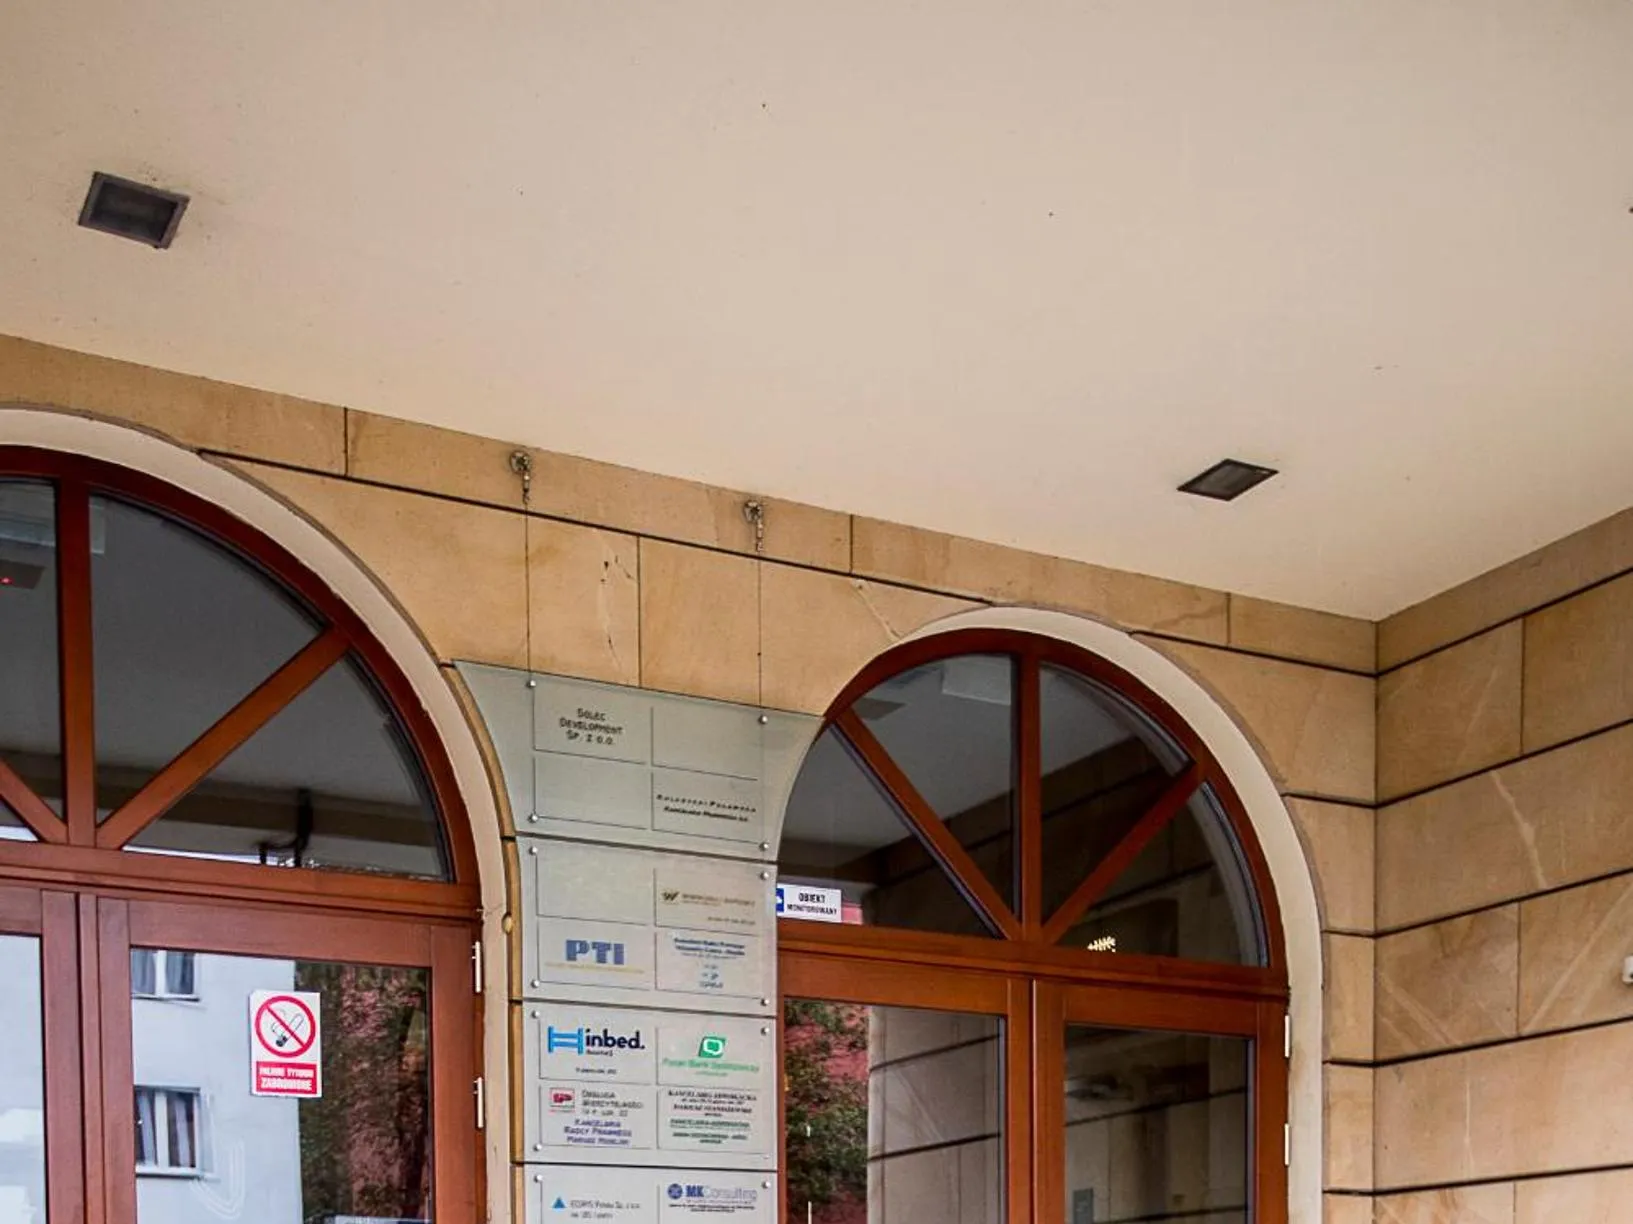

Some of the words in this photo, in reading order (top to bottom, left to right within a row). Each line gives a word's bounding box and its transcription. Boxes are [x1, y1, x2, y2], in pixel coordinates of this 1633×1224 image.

[559, 717, 623, 735] DEVELOPMENT
[798, 892, 826, 904] OBIEKT
[565, 939, 625, 966] PTI
[585, 1027, 646, 1050] inbed.
